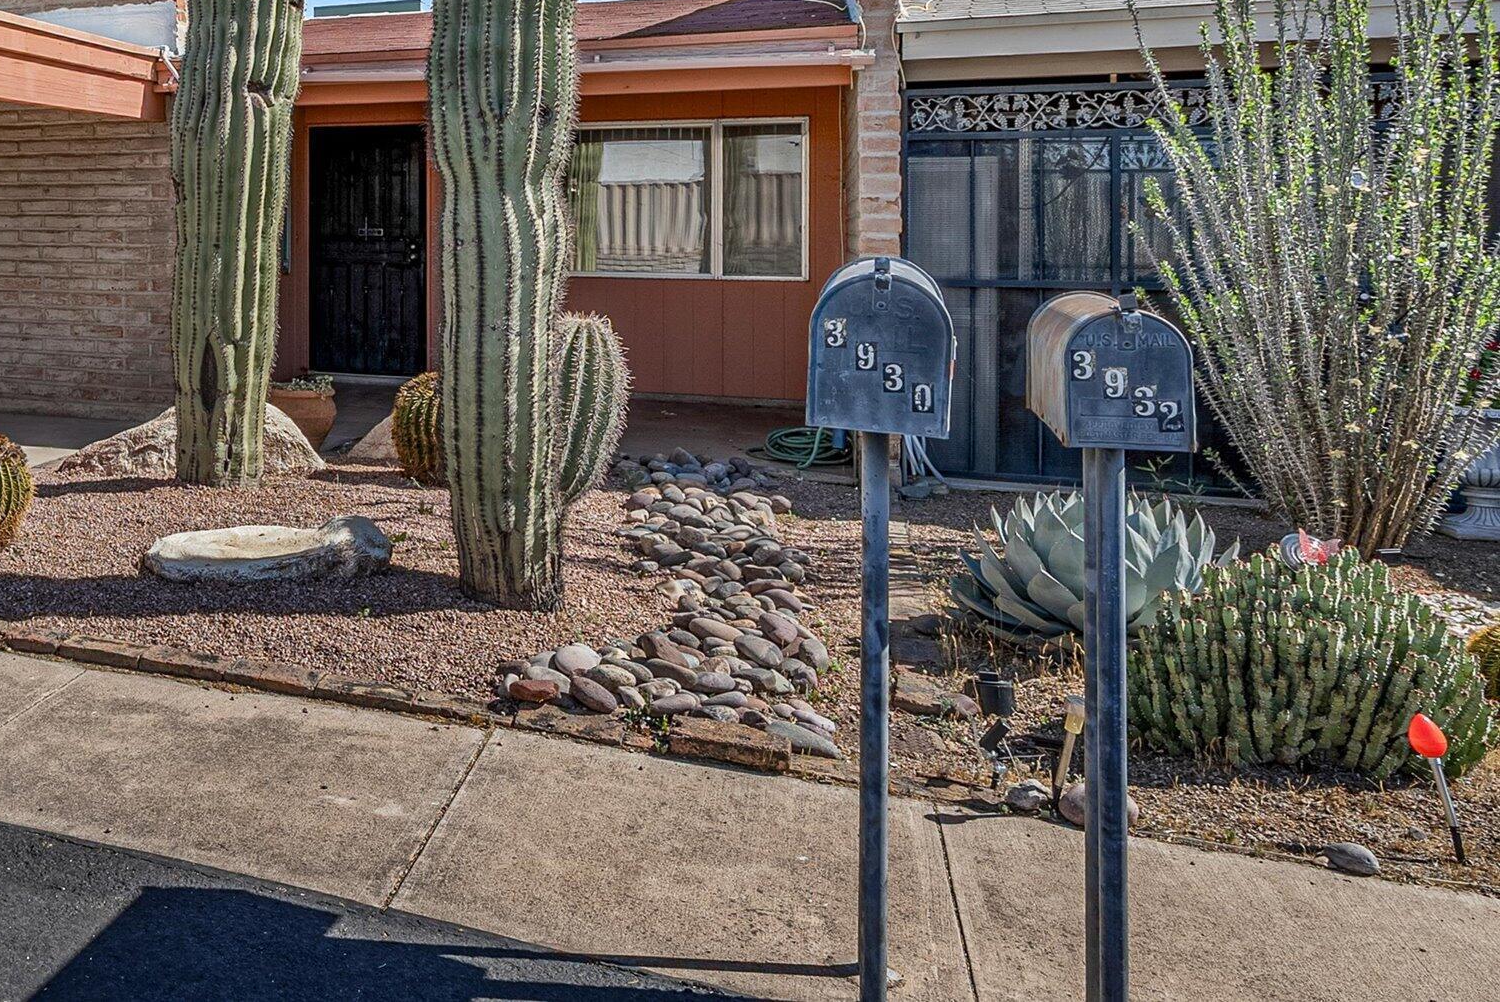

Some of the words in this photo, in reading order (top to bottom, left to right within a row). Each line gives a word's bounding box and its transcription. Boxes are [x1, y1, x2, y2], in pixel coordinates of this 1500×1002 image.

[826, 319, 932, 412] 3930
[1085, 333, 1118, 347] U.S.
[1137, 333, 1176, 347] MAIL
[1072, 350, 1182, 431] 3932
